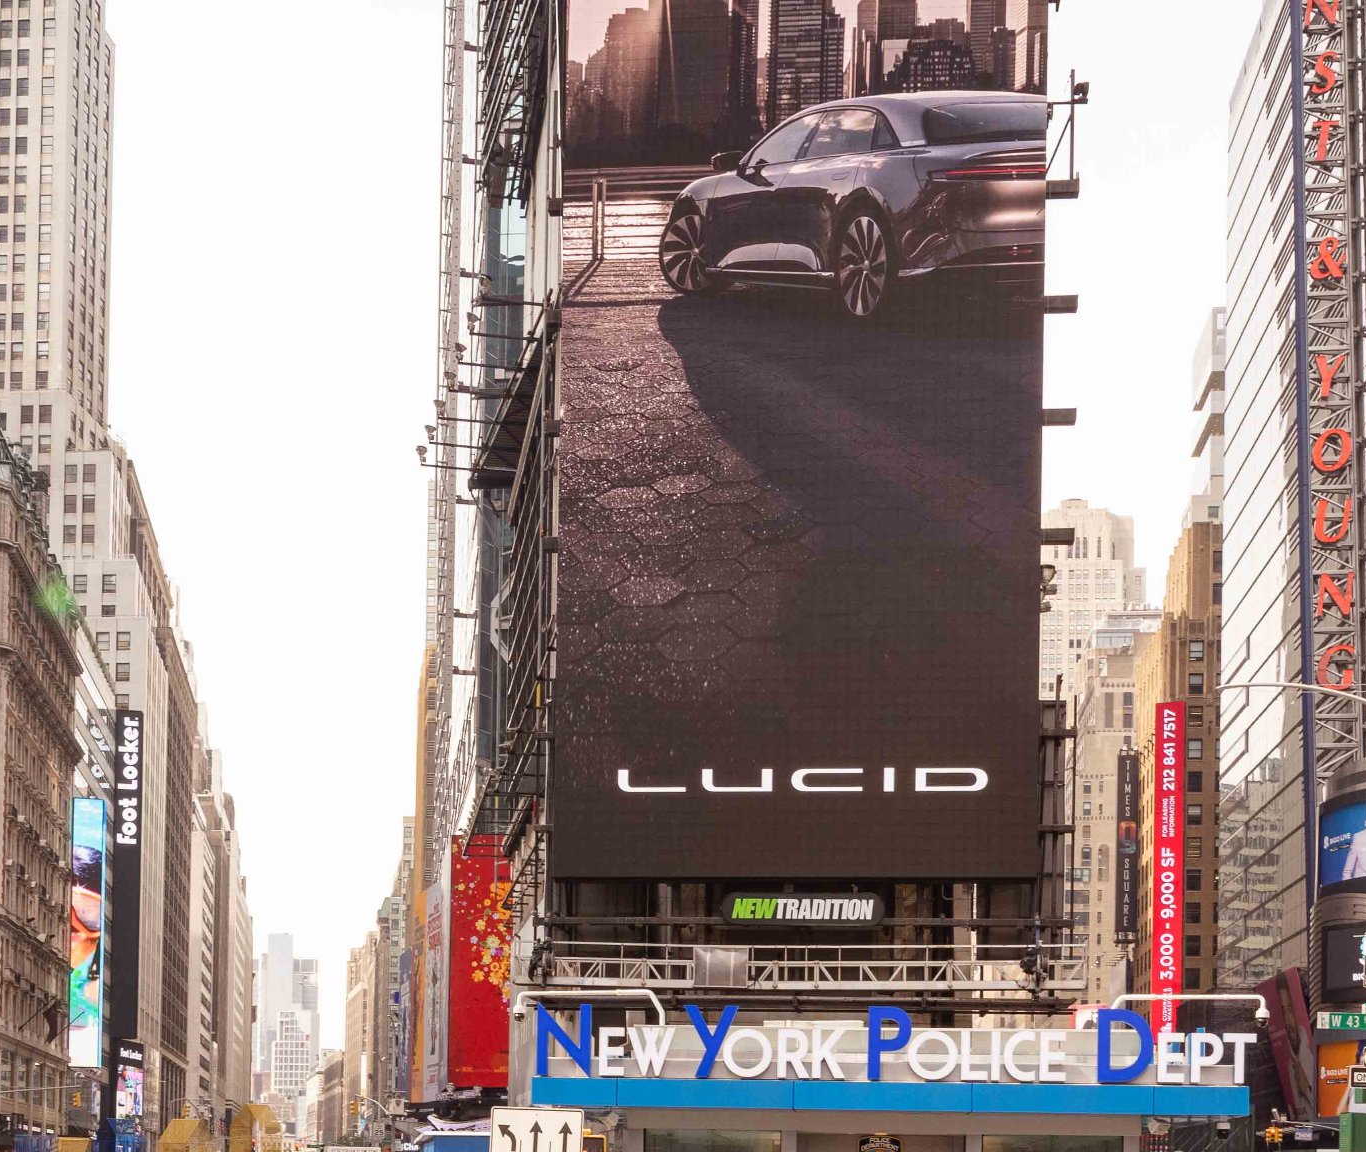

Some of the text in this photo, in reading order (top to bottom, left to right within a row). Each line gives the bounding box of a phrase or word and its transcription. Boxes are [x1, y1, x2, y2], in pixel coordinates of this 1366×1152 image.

[1310, 237, 1346, 280] &
[1312, 355, 1355, 690] YOUNG
[1163, 709, 1176, 791] 212 841 7517
[616, 766, 989, 795] LUCID
[1124, 760, 1132, 817] TIMES
[117, 797, 137, 844] Foot
[1160, 847, 1177, 980] 3,000 9,000 SF
[1331, 1015, 1360, 1028] W 43
[860, 1143, 899, 1151] DEPARTMENT
